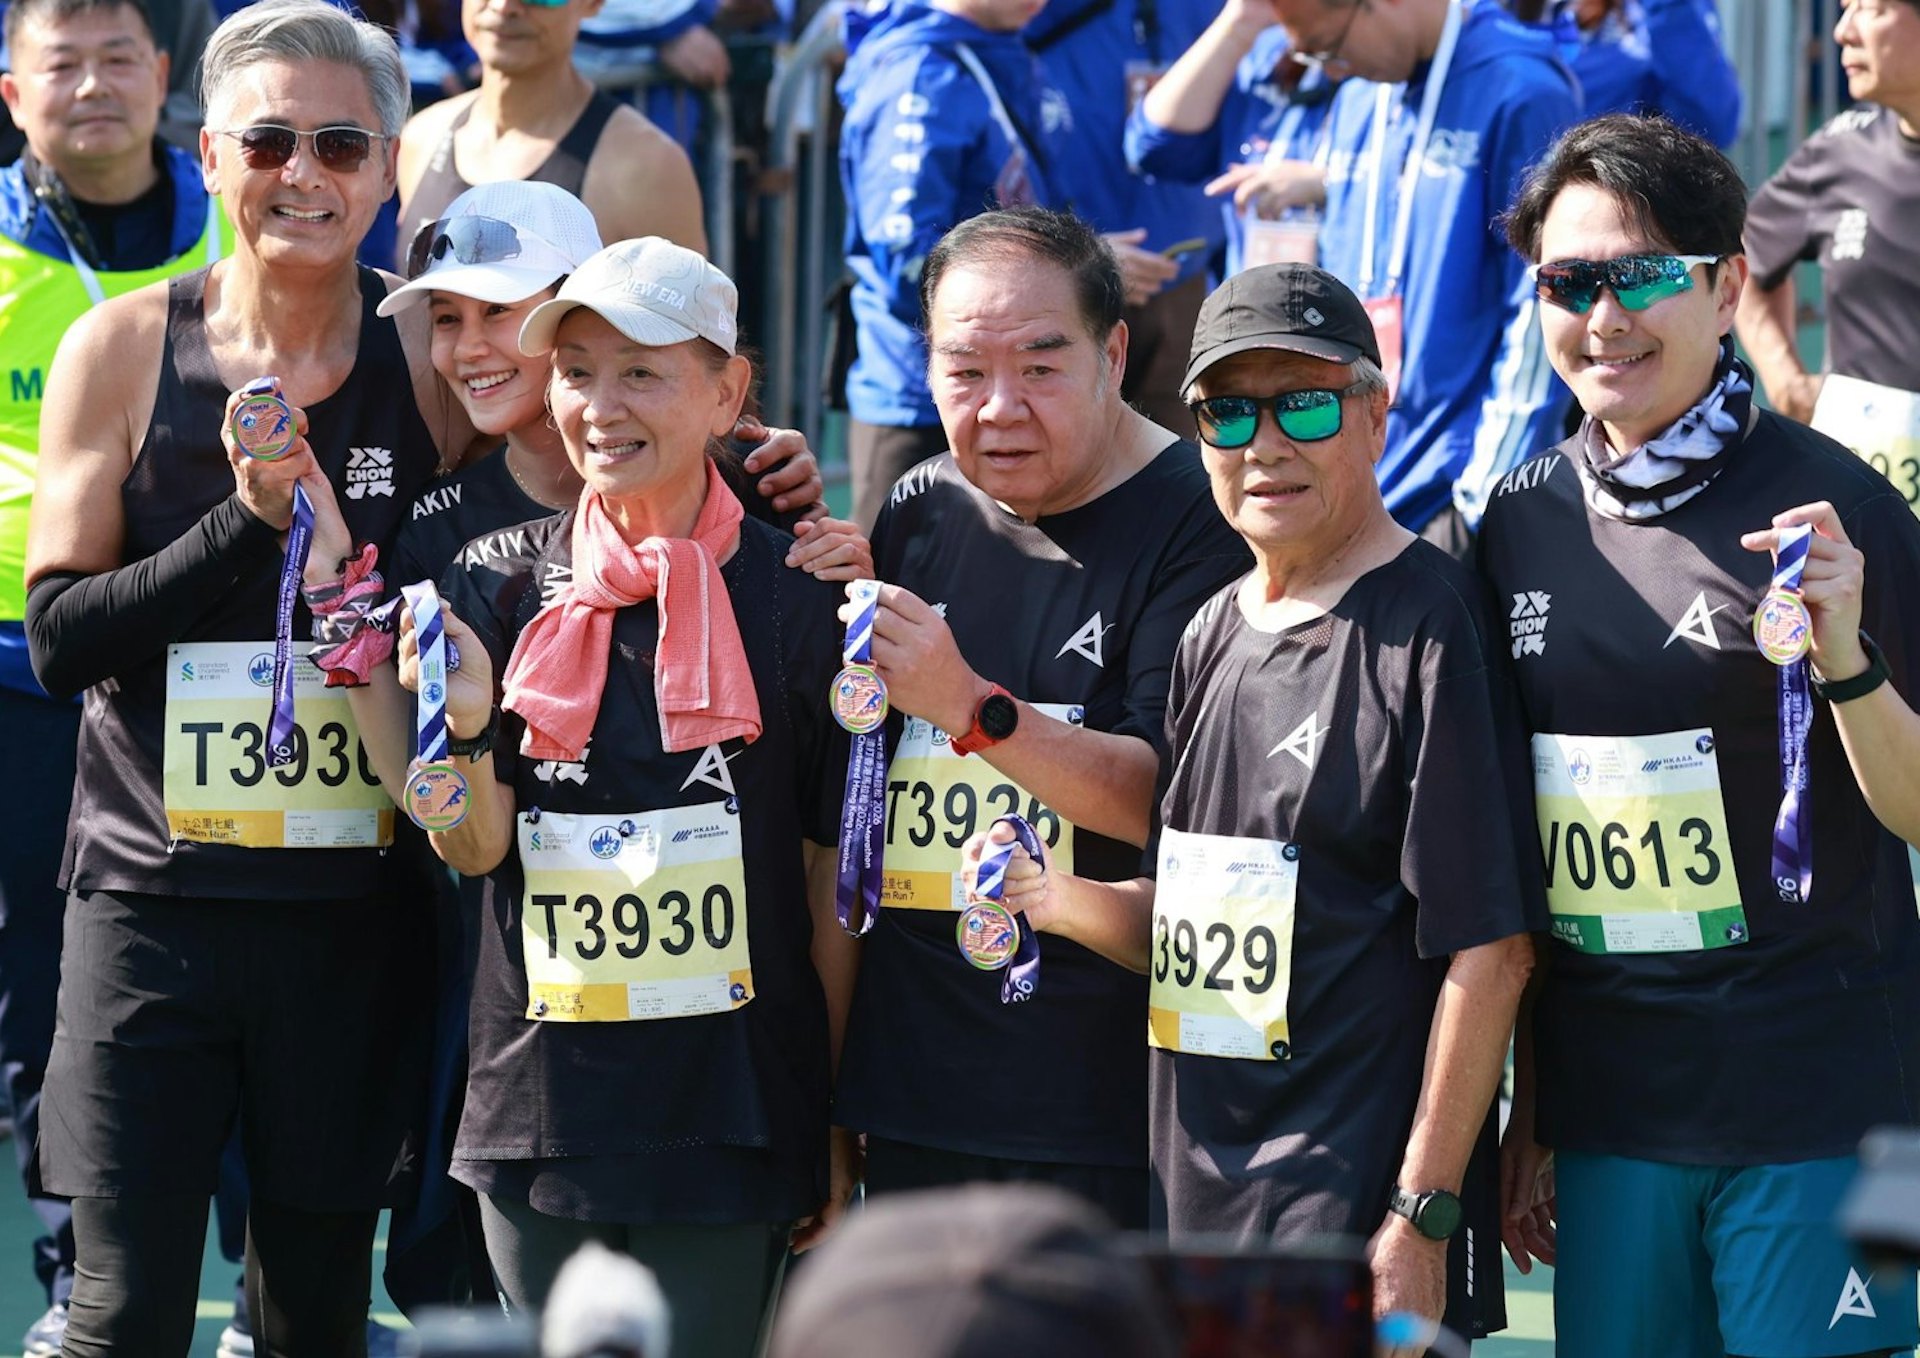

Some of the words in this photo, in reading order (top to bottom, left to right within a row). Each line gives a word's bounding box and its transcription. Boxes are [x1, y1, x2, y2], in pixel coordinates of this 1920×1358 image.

[656, 286, 687, 311] ERA
[346, 466, 394, 482] CHOW
[891, 461, 943, 509] AKIV
[1499, 455, 1561, 497] AKIV
[413, 483, 462, 521] AKIV
[465, 530, 524, 573] AKIV
[1511, 616, 1548, 638] CHOW
[1783, 690, 1794, 738] Chartered
[852, 734, 866, 779] Chartered
[1783, 738, 1794, 765] Hong
[848, 779, 860, 805] Hong
[844, 805, 856, 829] Kong
[855, 805, 868, 831] 2026
[840, 829, 853, 873] Marathon
[881, 879, 912, 891] 公里七組
[893, 889, 909, 901] Run
[909, 890, 915, 901] 7
[531, 884, 734, 960] T3930
[1154, 912, 1278, 995] 3929
[560, 1004, 576, 1014] Run
[578, 1004, 584, 1014] 7
